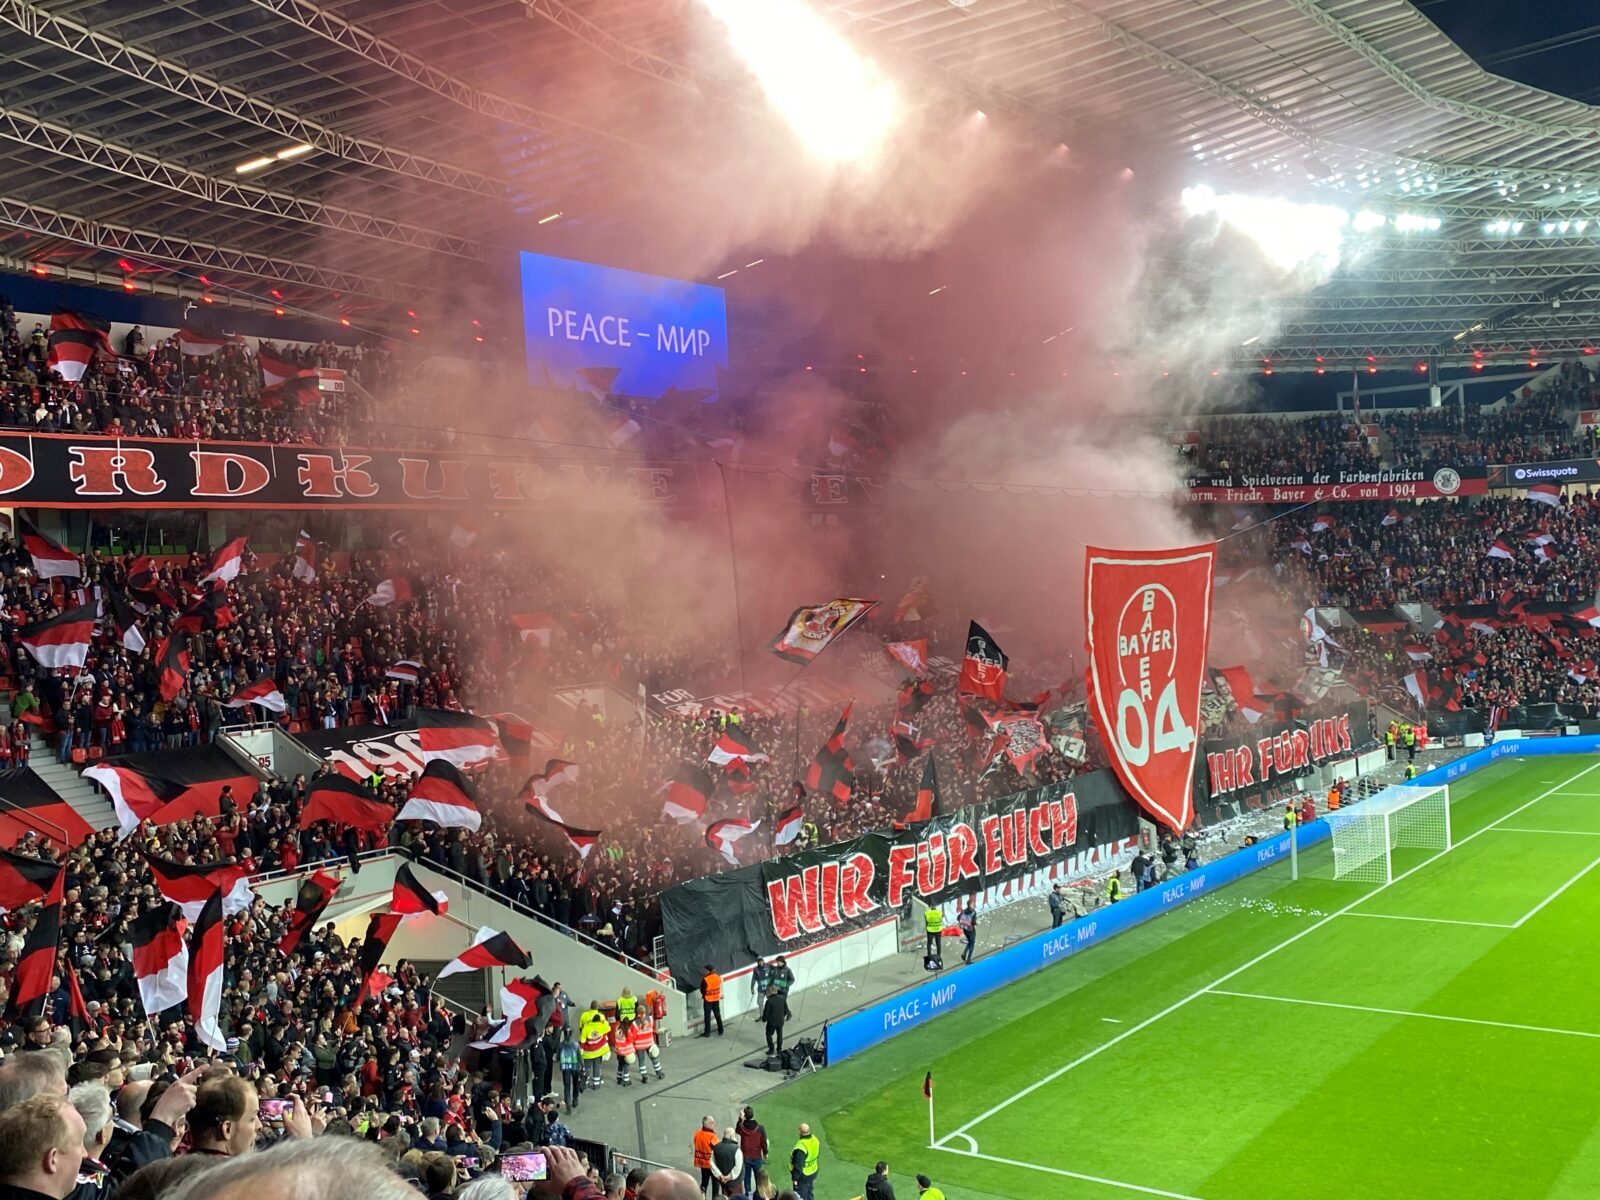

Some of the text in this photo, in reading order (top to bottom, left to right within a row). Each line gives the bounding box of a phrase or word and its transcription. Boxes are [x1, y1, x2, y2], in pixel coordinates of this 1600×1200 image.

[547, 306, 632, 348] PEACE
[656, 323, 711, 357] МИР
[1211, 476, 1233, 488] und
[1242, 474, 1304, 489] Spielverein
[1312, 472, 1331, 484] der
[1339, 469, 1425, 487] Farbenfabriken
[1526, 467, 1578, 478] Swissquote
[1184, 492, 1217, 501] vorm.
[1226, 489, 1265, 502] Friedr.
[1273, 487, 1306, 503] Bayer
[1332, 485, 1351, 499] Co.
[1360, 487, 1379, 498] von
[1388, 484, 1417, 498] 1904
[1118, 629, 1172, 657] BAYER
[1140, 590, 1155, 702] BAYER
[652, 688, 695, 704] FÜR
[1116, 678, 1197, 767] 04
[1206, 713, 1351, 798] IHR FÜR UNS
[766, 851, 876, 941] WIR
[887, 823, 979, 907] FÜR
[981, 792, 1078, 876] EUCH
[1162, 883, 1185, 904] PEACE
[1043, 935, 1070, 958] PEACE
[1077, 921, 1098, 943] МИР
[884, 999, 920, 1030] PEACE
[931, 983, 957, 1010] МИР
